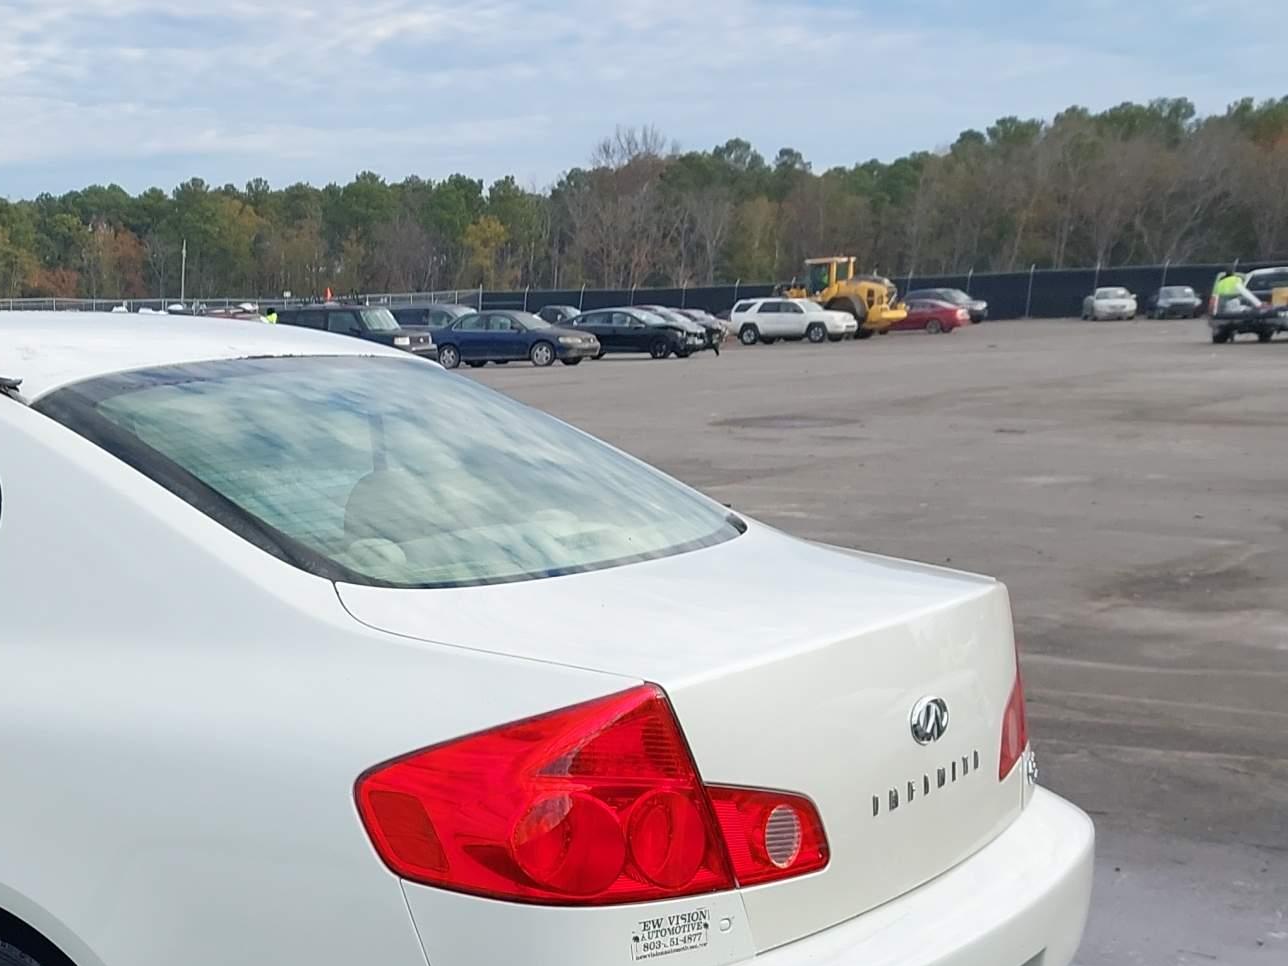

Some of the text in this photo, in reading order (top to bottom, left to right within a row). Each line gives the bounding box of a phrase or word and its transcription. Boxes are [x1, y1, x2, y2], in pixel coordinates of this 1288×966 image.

[639, 909, 707, 932] EW VISION
[641, 921, 703, 941] AUTOMOTIVE
